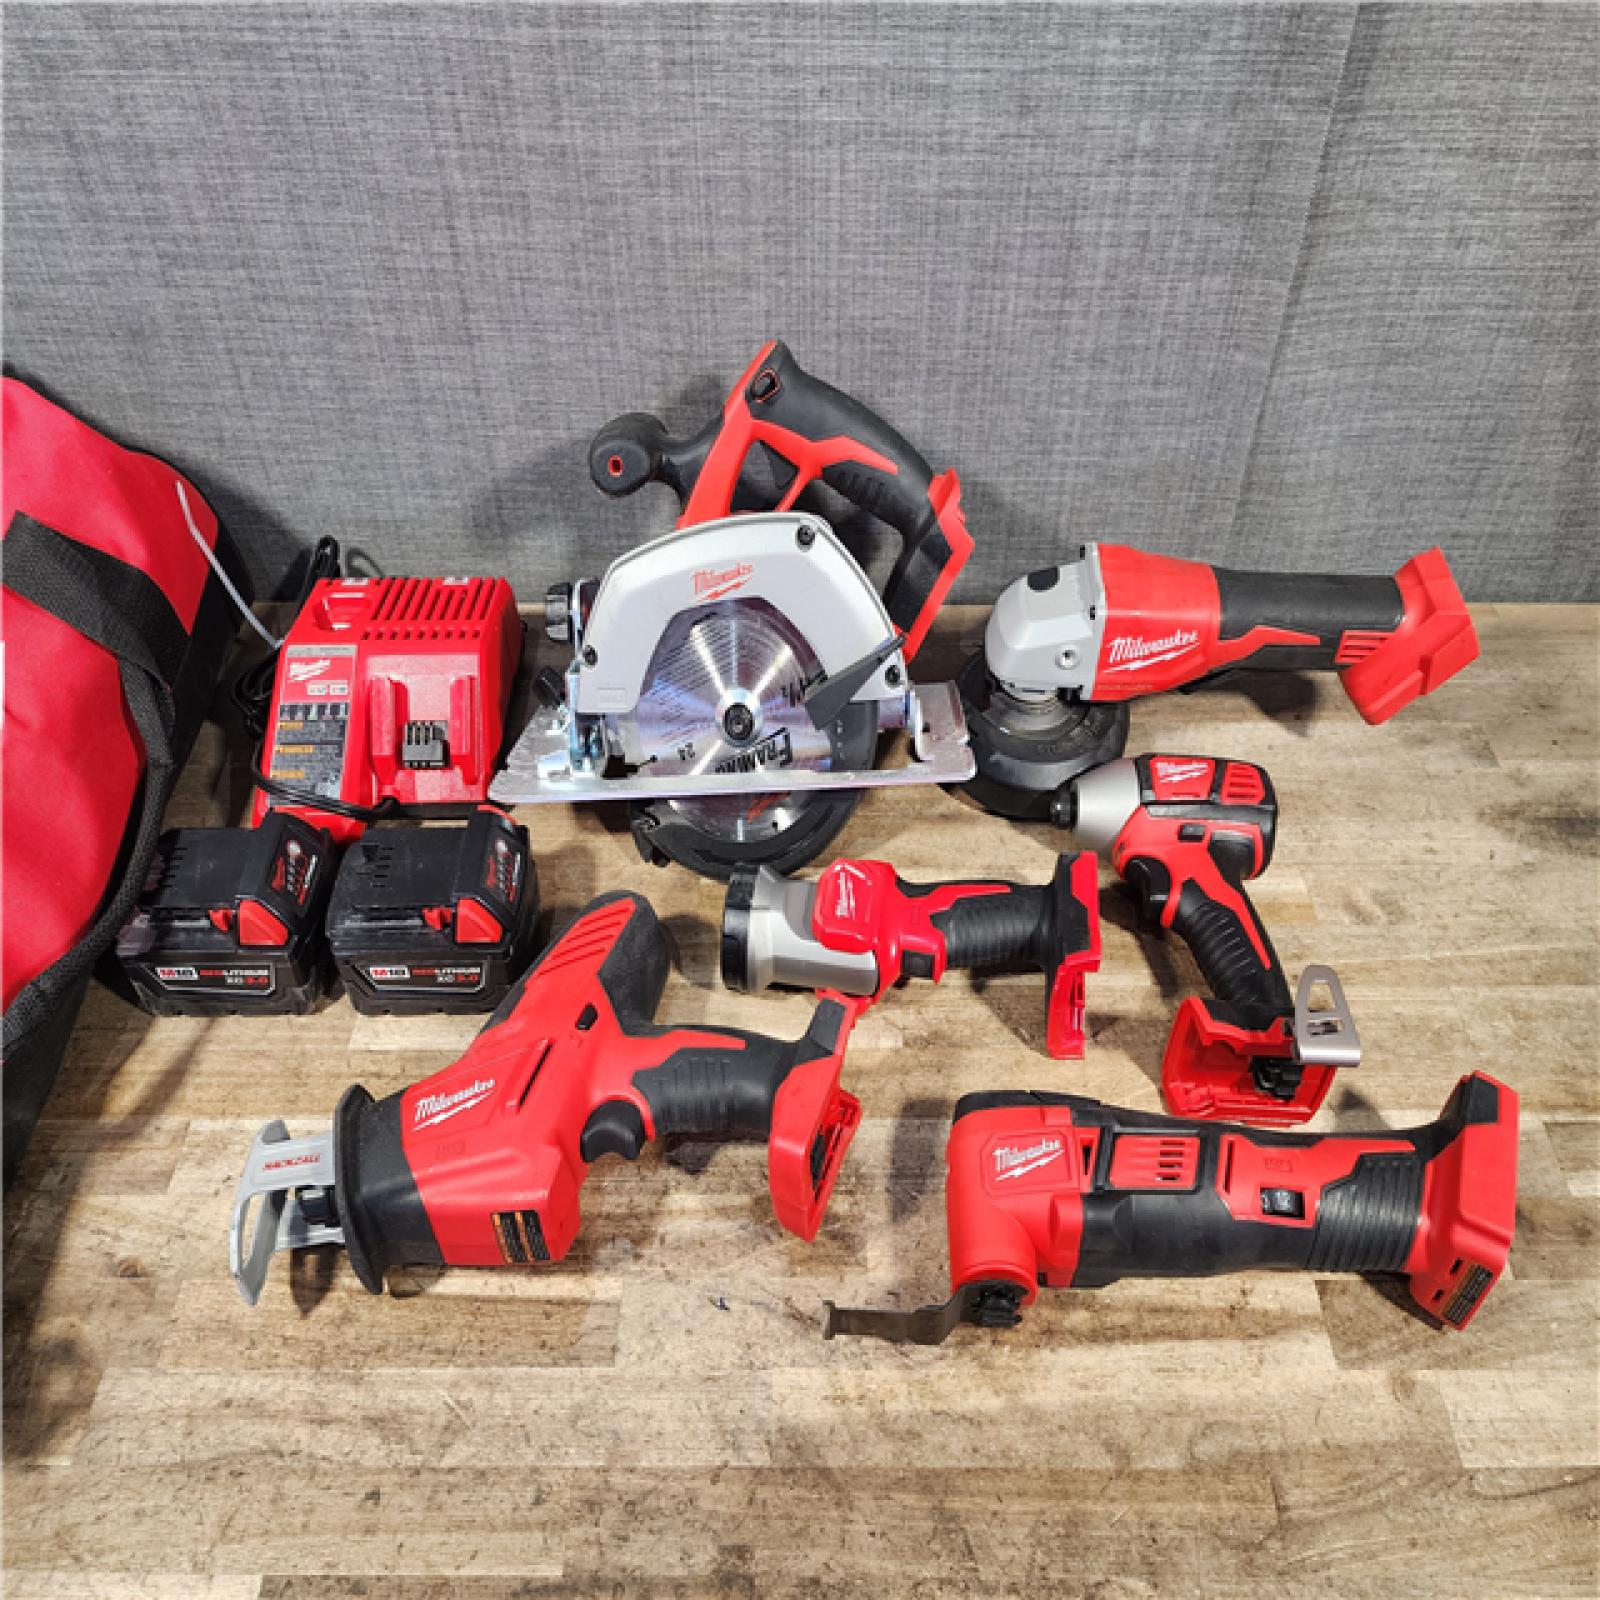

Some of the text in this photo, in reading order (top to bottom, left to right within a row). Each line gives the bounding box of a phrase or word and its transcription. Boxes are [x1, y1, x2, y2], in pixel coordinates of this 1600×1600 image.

[1108, 629, 1199, 663] Milwaukee
[414, 1077, 496, 1123] Milwaukee
[992, 1136, 1062, 1173] Milwaukee
